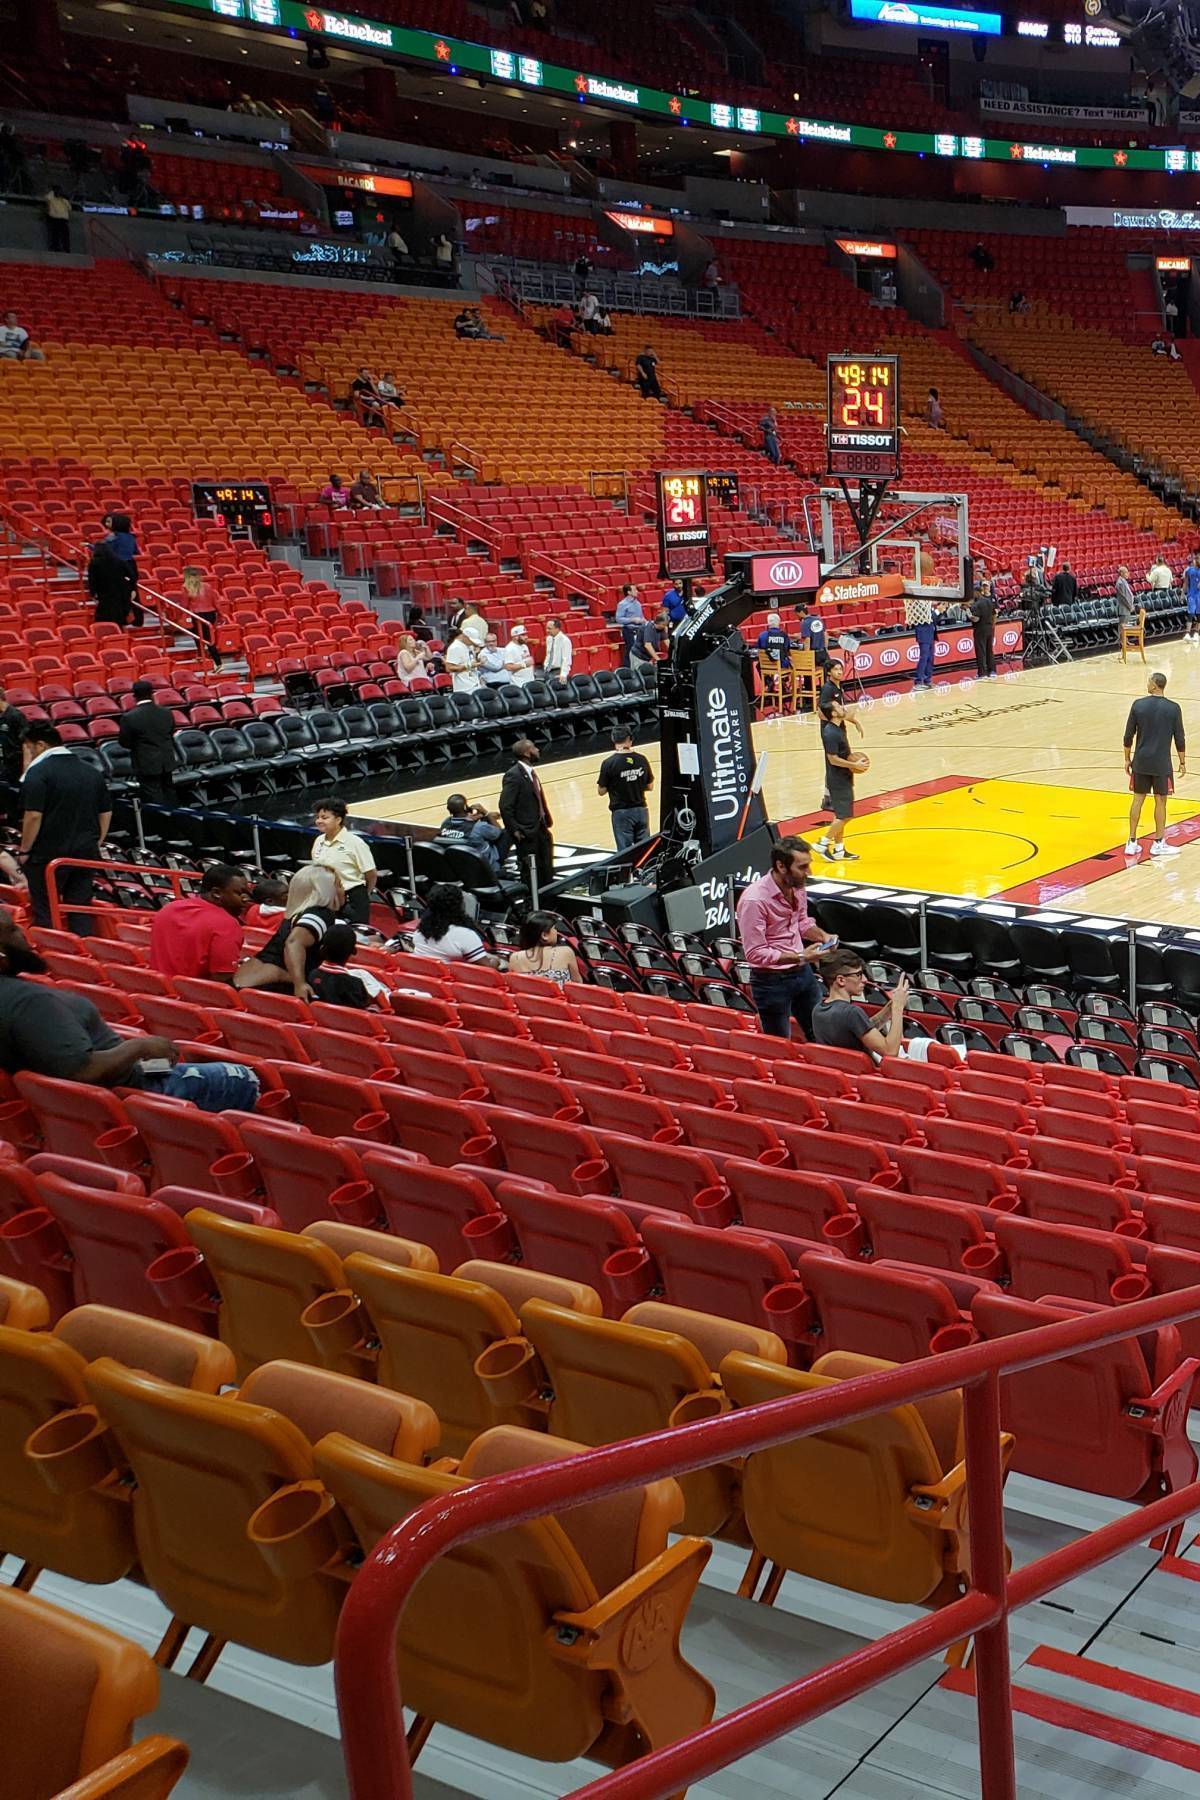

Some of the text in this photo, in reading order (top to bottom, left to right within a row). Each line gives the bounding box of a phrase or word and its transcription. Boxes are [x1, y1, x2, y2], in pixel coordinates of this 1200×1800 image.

[323, 14, 393, 47] Heineken
[588, 79, 639, 104] Heineken
[983, 100, 1010, 111] NEED
[1013, 101, 1080, 116] ASSISTANCE?
[1084, 109, 1104, 118] Text
[799, 121, 851, 141] Heineken
[1023, 146, 1076, 163] Heineken
[837, 364, 889, 386] 49:14
[842, 388, 883, 426] 24
[848, 434, 893, 446] TISSOT
[216, 489, 254, 501] 49:14
[664, 478, 699, 497] 49:14
[671, 498, 695, 522] 24
[680, 530, 708, 541] TISSOT
[775, 566, 797, 581] KIA
[686, 604, 715, 640] SPALDING
[958, 641, 972, 650] KIA
[1004, 634, 1017, 643] KIA
[884, 652, 898, 663] KIA
[663, 710, 690, 719] SPALDING
[707, 687, 739, 821] Ultimate
[730, 709, 748, 793] SOFTWARE
[705, 901, 738, 930] Blu
